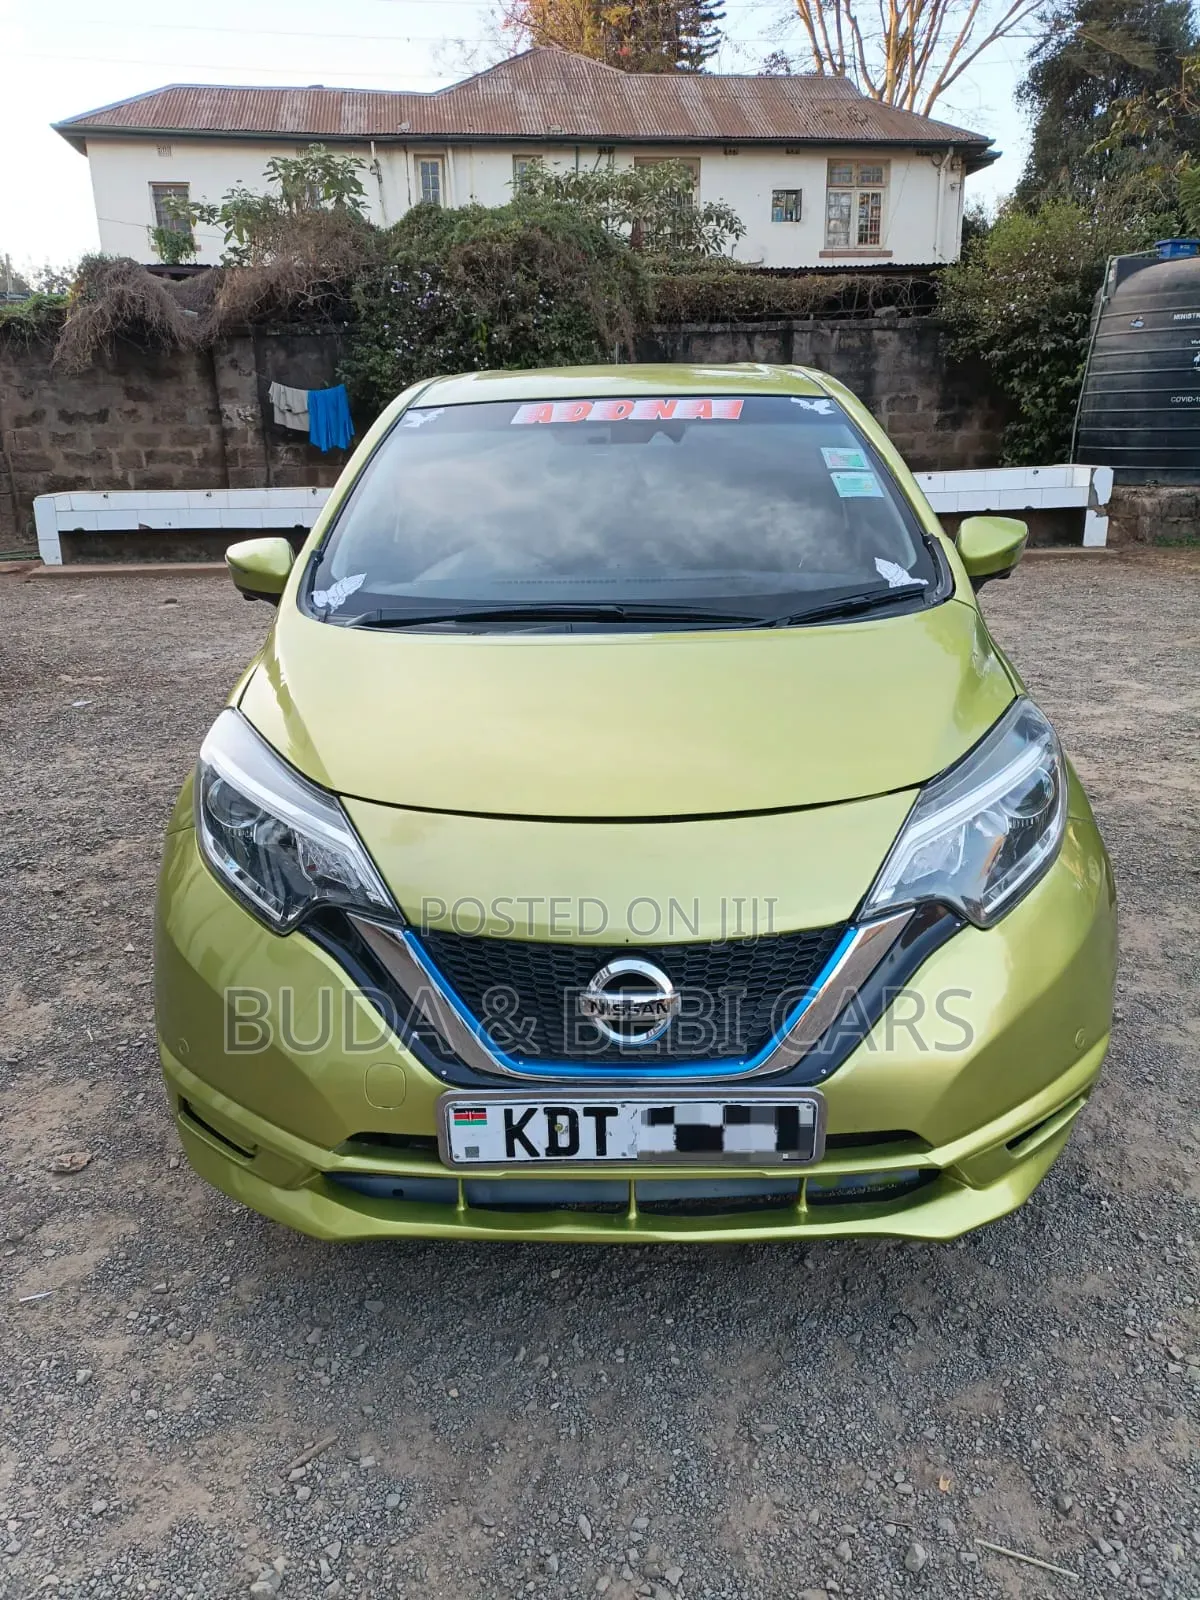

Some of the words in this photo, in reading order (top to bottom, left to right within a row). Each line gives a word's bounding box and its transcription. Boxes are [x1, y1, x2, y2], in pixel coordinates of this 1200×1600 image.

[511, 399, 745, 425] ADONAI
[589, 1002, 670, 1018] NISSAN
[503, 1106, 619, 1158] KDT
